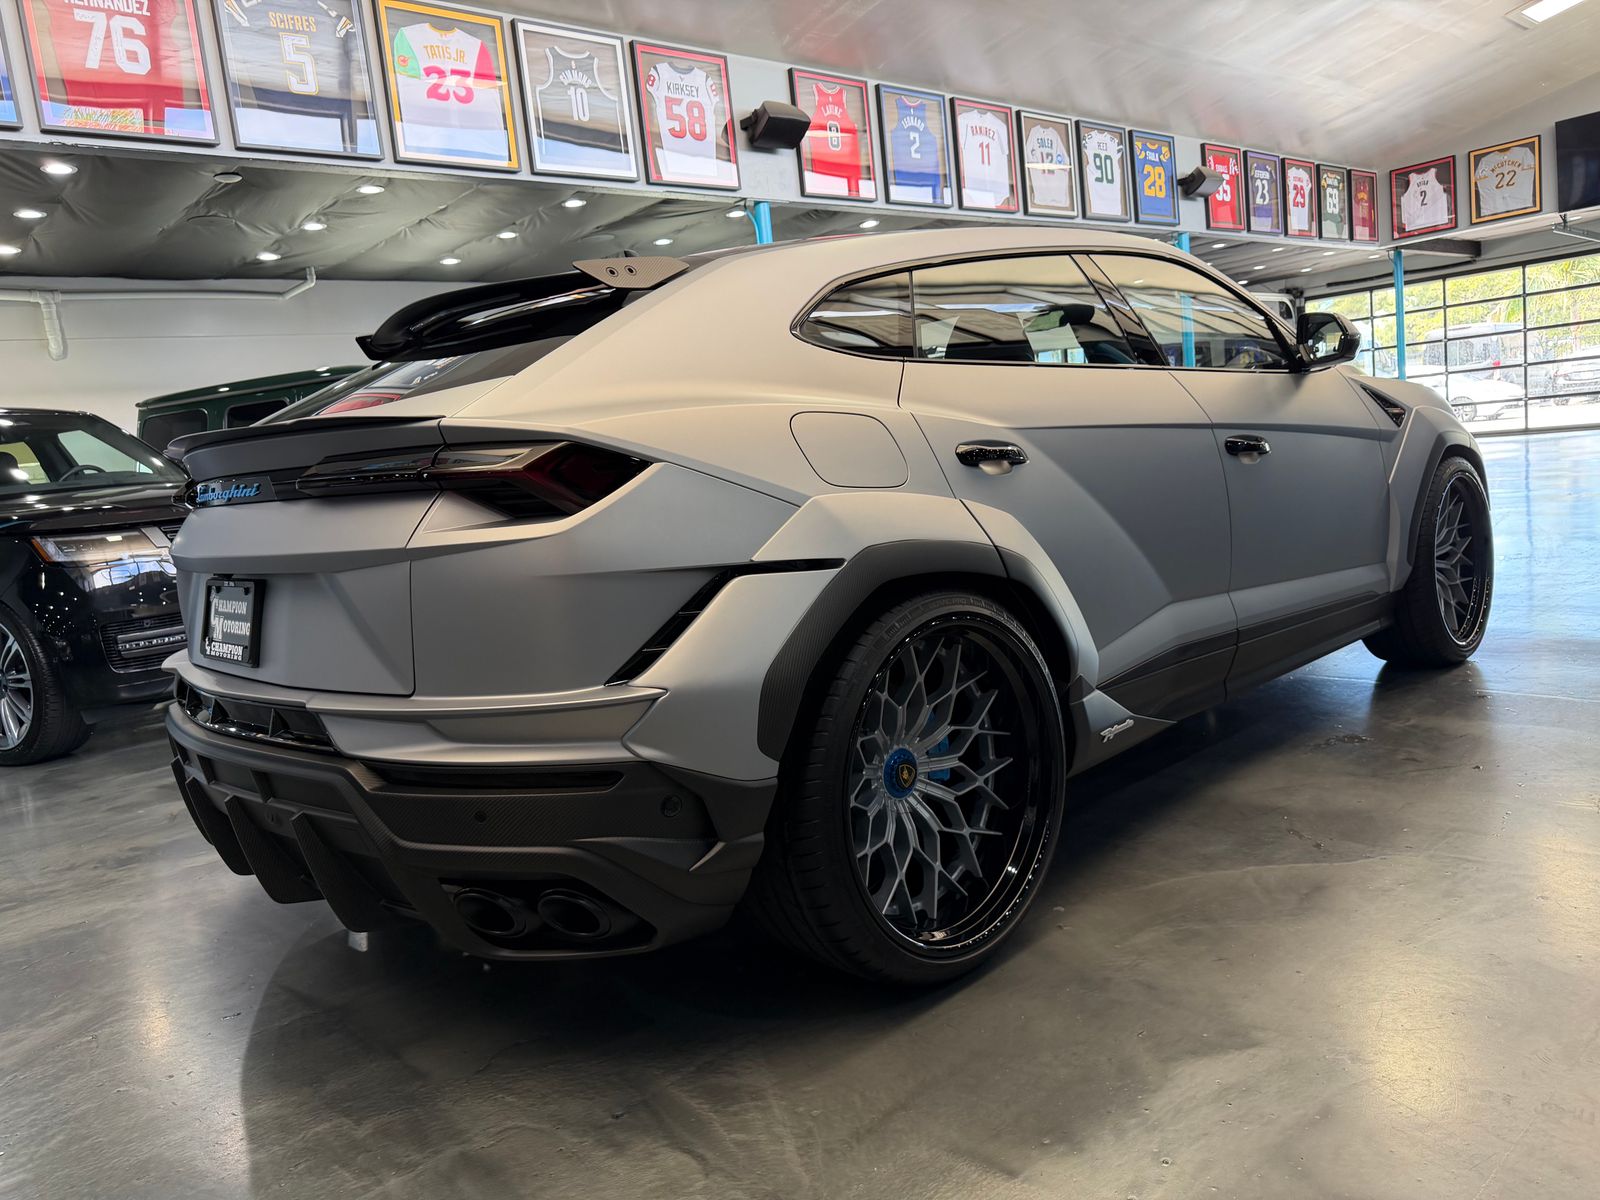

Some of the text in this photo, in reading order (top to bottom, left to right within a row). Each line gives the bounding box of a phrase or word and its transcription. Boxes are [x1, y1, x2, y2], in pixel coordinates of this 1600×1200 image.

[268, 11, 317, 32] SCIFRES
[73, 8, 152, 75] 76
[423, 45, 452, 61] TATIS
[279, 32, 319, 95] 5
[666, 82, 699, 98] KIRKSEY
[567, 86, 589, 121] 10
[665, 96, 707, 141] 58
[827, 121, 841, 151] 8
[910, 131, 921, 158] 2
[979, 142, 991, 166] 11
[1093, 152, 1114, 184] 90
[1495, 169, 1517, 190] 22
[1143, 164, 1166, 199] 28
[1255, 179, 1269, 204] 23
[1293, 184, 1305, 208] 29
[1420, 190, 1427, 207] 2
[211, 598, 247, 627] CHAMPION
[213, 615, 250, 641] MOTORING
[211, 642, 243, 656] CHAMPION
[211, 651, 242, 661] MOTORING
